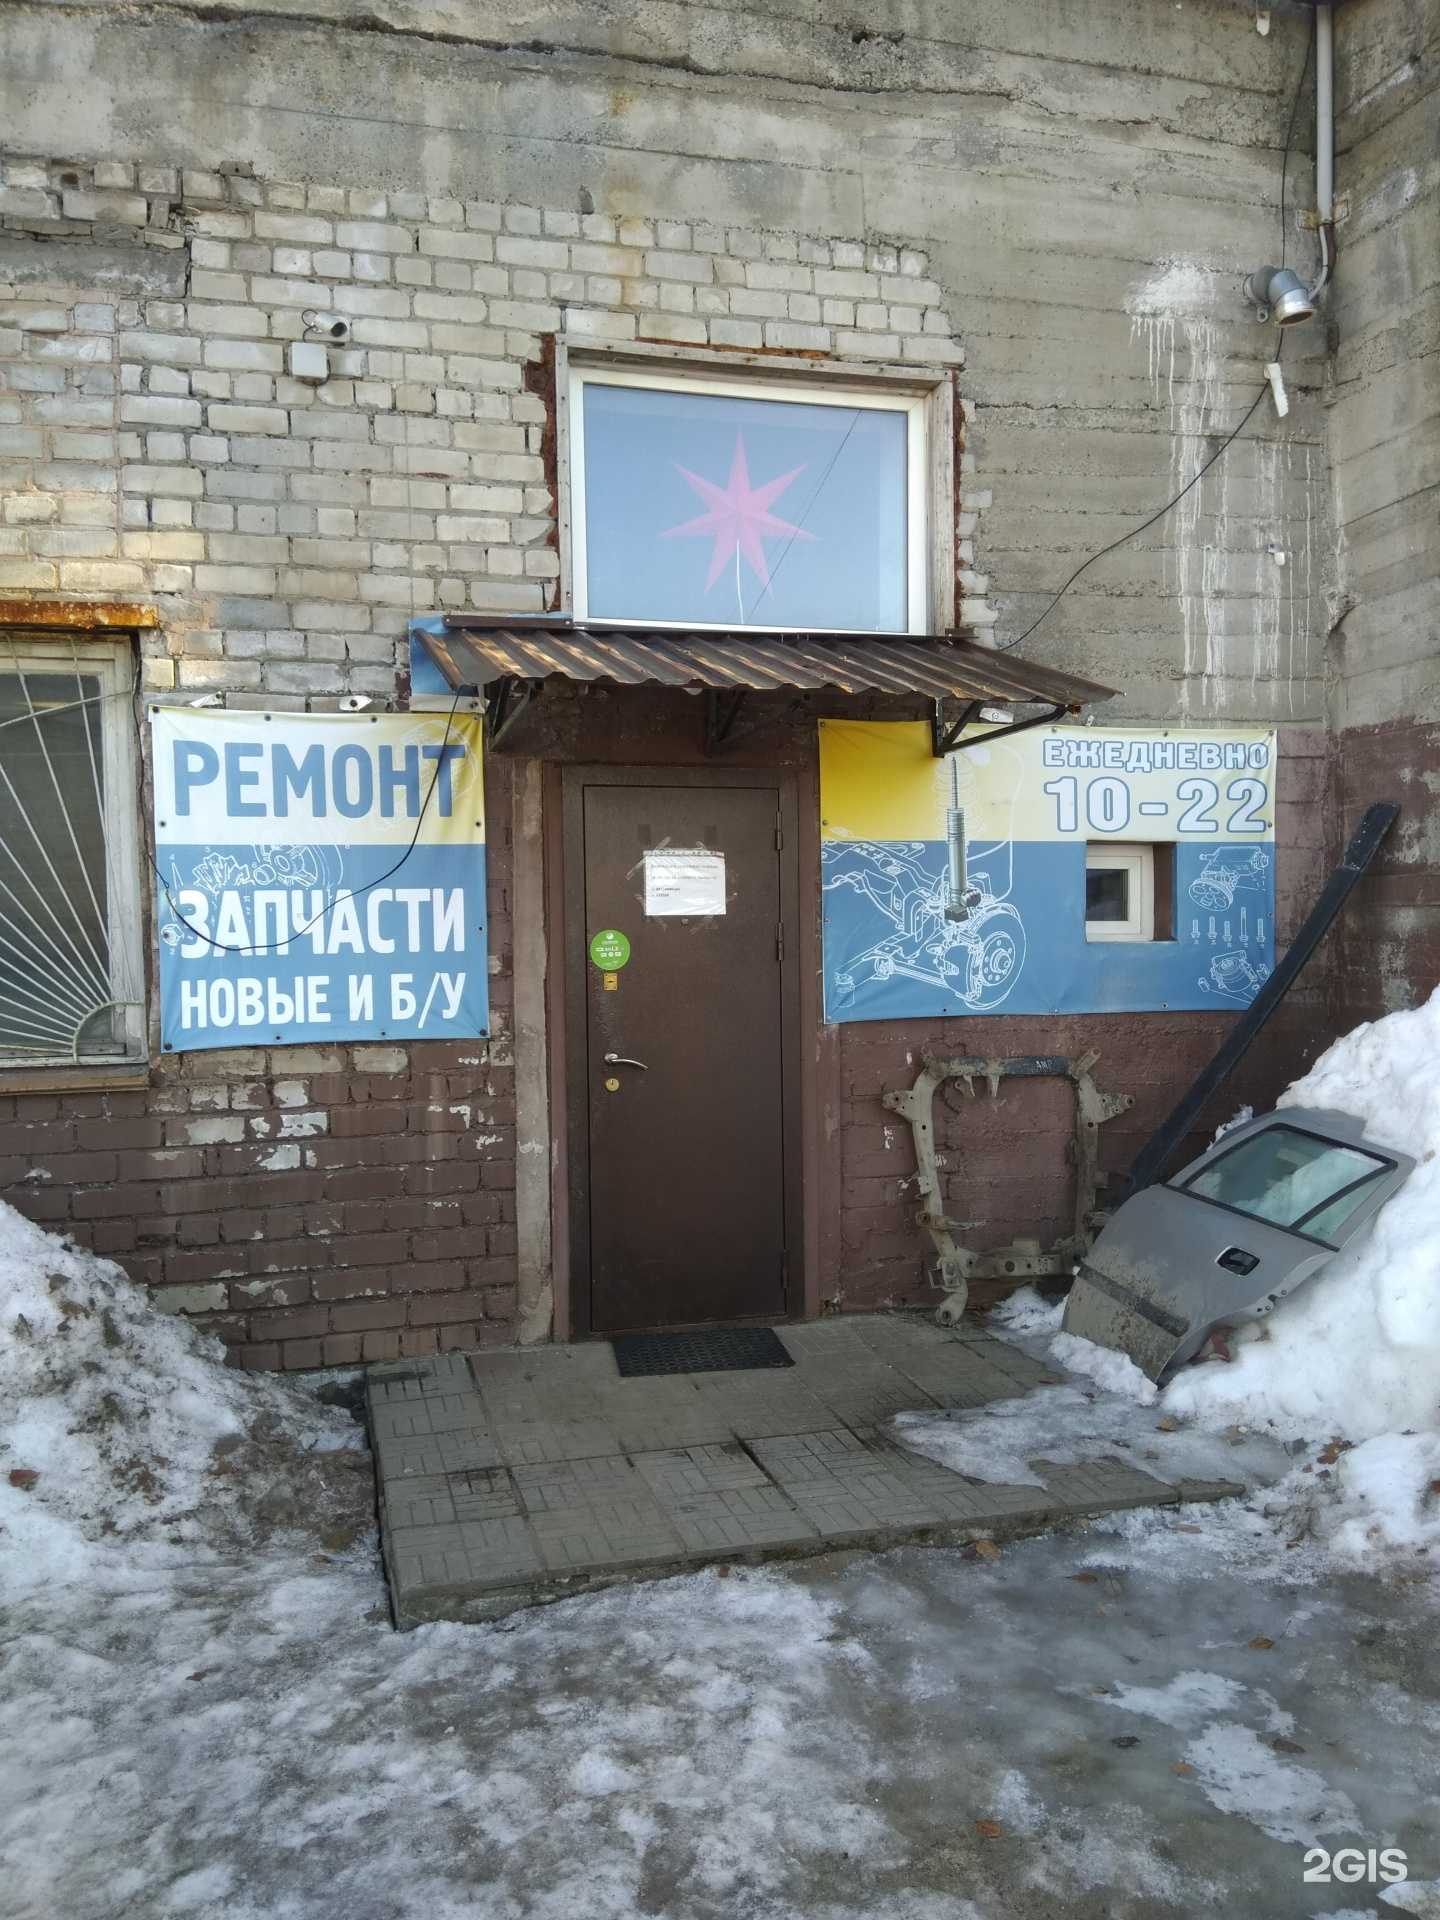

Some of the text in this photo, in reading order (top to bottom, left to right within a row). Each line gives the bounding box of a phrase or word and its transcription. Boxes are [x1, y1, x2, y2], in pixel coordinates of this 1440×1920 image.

[172, 739, 466, 819] РЕМОНТ
[1042, 739, 1269, 773] ЕЖЕДНЕВНО
[1043, 776, 1268, 833] 10-22
[178, 887, 466, 959] ЗАПЧАСТИ
[180, 972, 467, 1030] НОВЫЕ И Б/У
